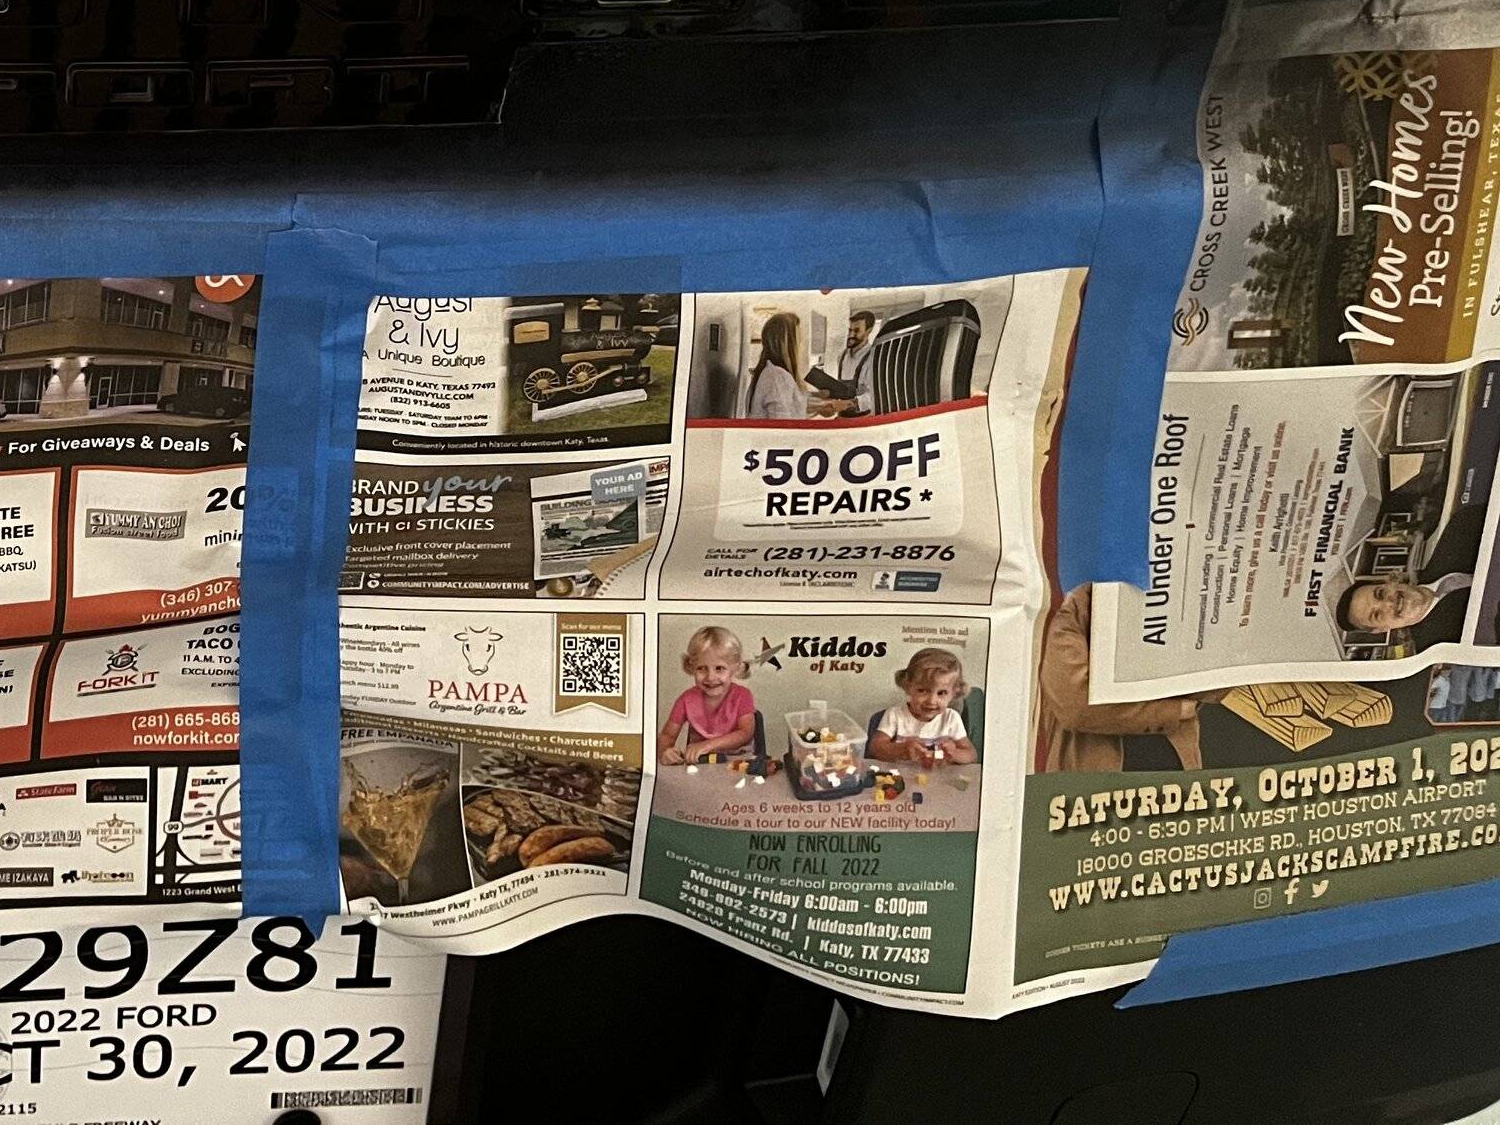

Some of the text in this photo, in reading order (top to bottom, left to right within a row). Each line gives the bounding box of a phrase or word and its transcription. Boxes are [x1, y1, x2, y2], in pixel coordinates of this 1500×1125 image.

[1191, 95, 1232, 293] CROSS CREEK WEST
[1338, 70, 1438, 348] New Homes
[1409, 110, 1481, 309] Pre-Selling!
[388, 319, 460, 355] & Ivy
[378, 349, 486, 369] Unique Boutique
[8, 440, 38, 454] For
[42, 436, 136, 454] Giveaways
[157, 437, 210, 452] Deals
[743, 433, 941, 486] $50 OFF
[766, 487, 912, 517] REPAIRS
[1143, 414, 1191, 648] All Under One Roof
[1304, 426, 1356, 620] FIRST FINANCIAL BANK
[763, 545, 956, 562] (281)-231-8876
[704, 566, 858, 581] airtechofkaty.com
[788, 636, 887, 659] Kiddos
[810, 660, 865, 674] of Katy
[427, 679, 529, 705] PAMPA
[549, 735, 614, 748] Charcuterie
[1047, 747, 1435, 833] SATURDAY, OCTOBER 1,
[1240, 779, 1488, 830] WEST HOUSTON AIRPORT
[807, 916, 932, 942] kiddosofkaty.com
[11, 1004, 218, 1035] 2022 FORD
[86, 1033, 198, 1087] 30,
[230, 1025, 407, 1075] 2022
